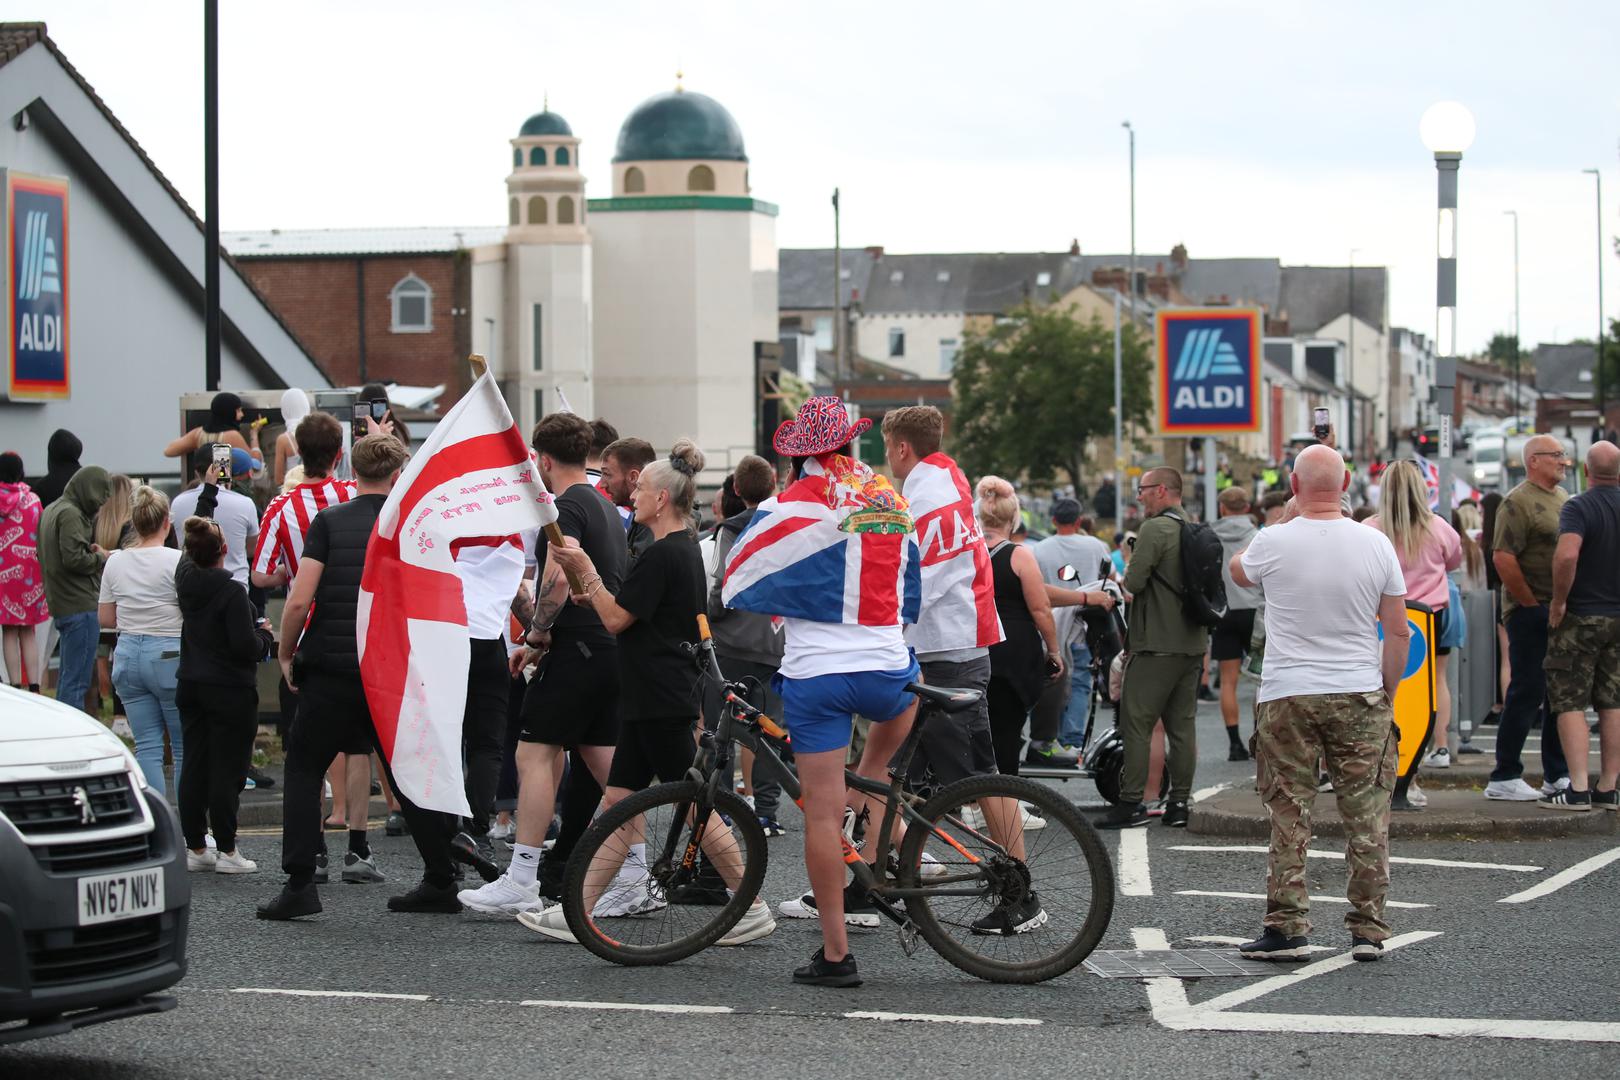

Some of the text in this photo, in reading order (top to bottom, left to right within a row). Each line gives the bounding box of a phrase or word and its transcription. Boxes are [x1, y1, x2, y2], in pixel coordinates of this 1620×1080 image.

[20, 312, 61, 352] ALDI
[1174, 386, 1244, 408] ALDI
[682, 842, 698, 869] XCM
[87, 873, 158, 917] NV67 NUY
